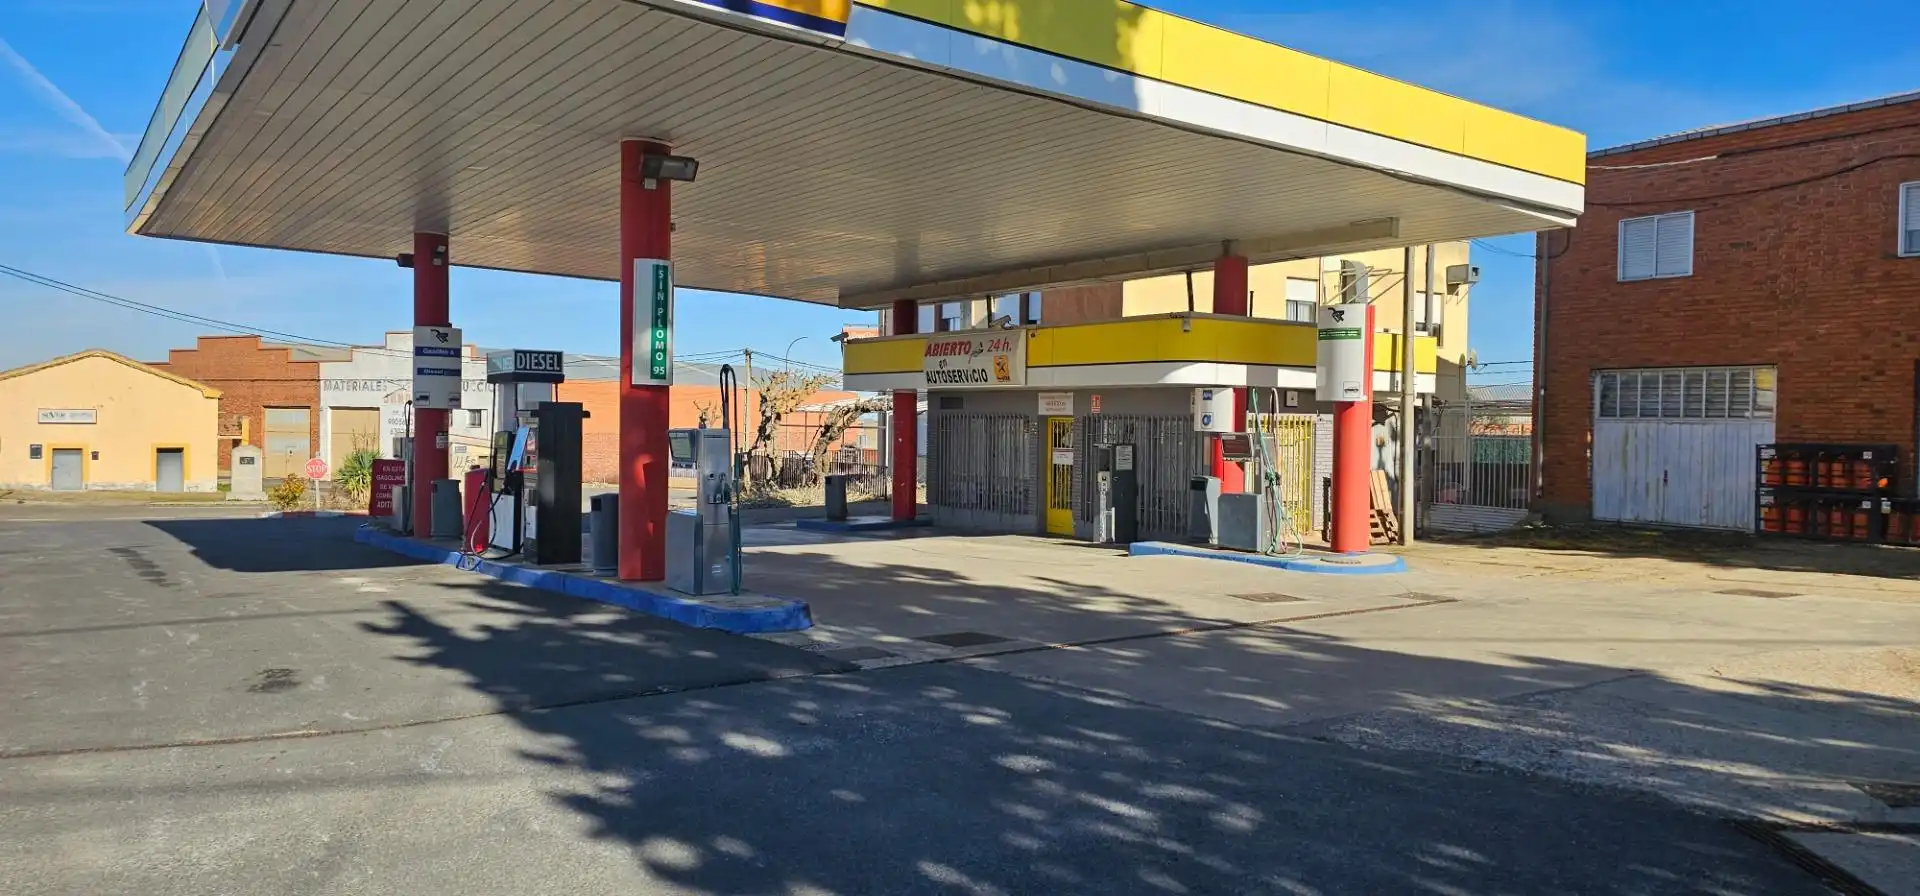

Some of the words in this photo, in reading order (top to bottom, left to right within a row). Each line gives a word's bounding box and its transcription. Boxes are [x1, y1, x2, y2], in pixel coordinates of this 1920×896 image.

[924, 341, 972, 357] ABIERTO
[987, 339, 1001, 353] 24
[516, 352, 560, 371] DIESEL
[939, 358, 948, 370] en
[653, 366, 665, 375] 95
[306, 464, 328, 473] STOP
